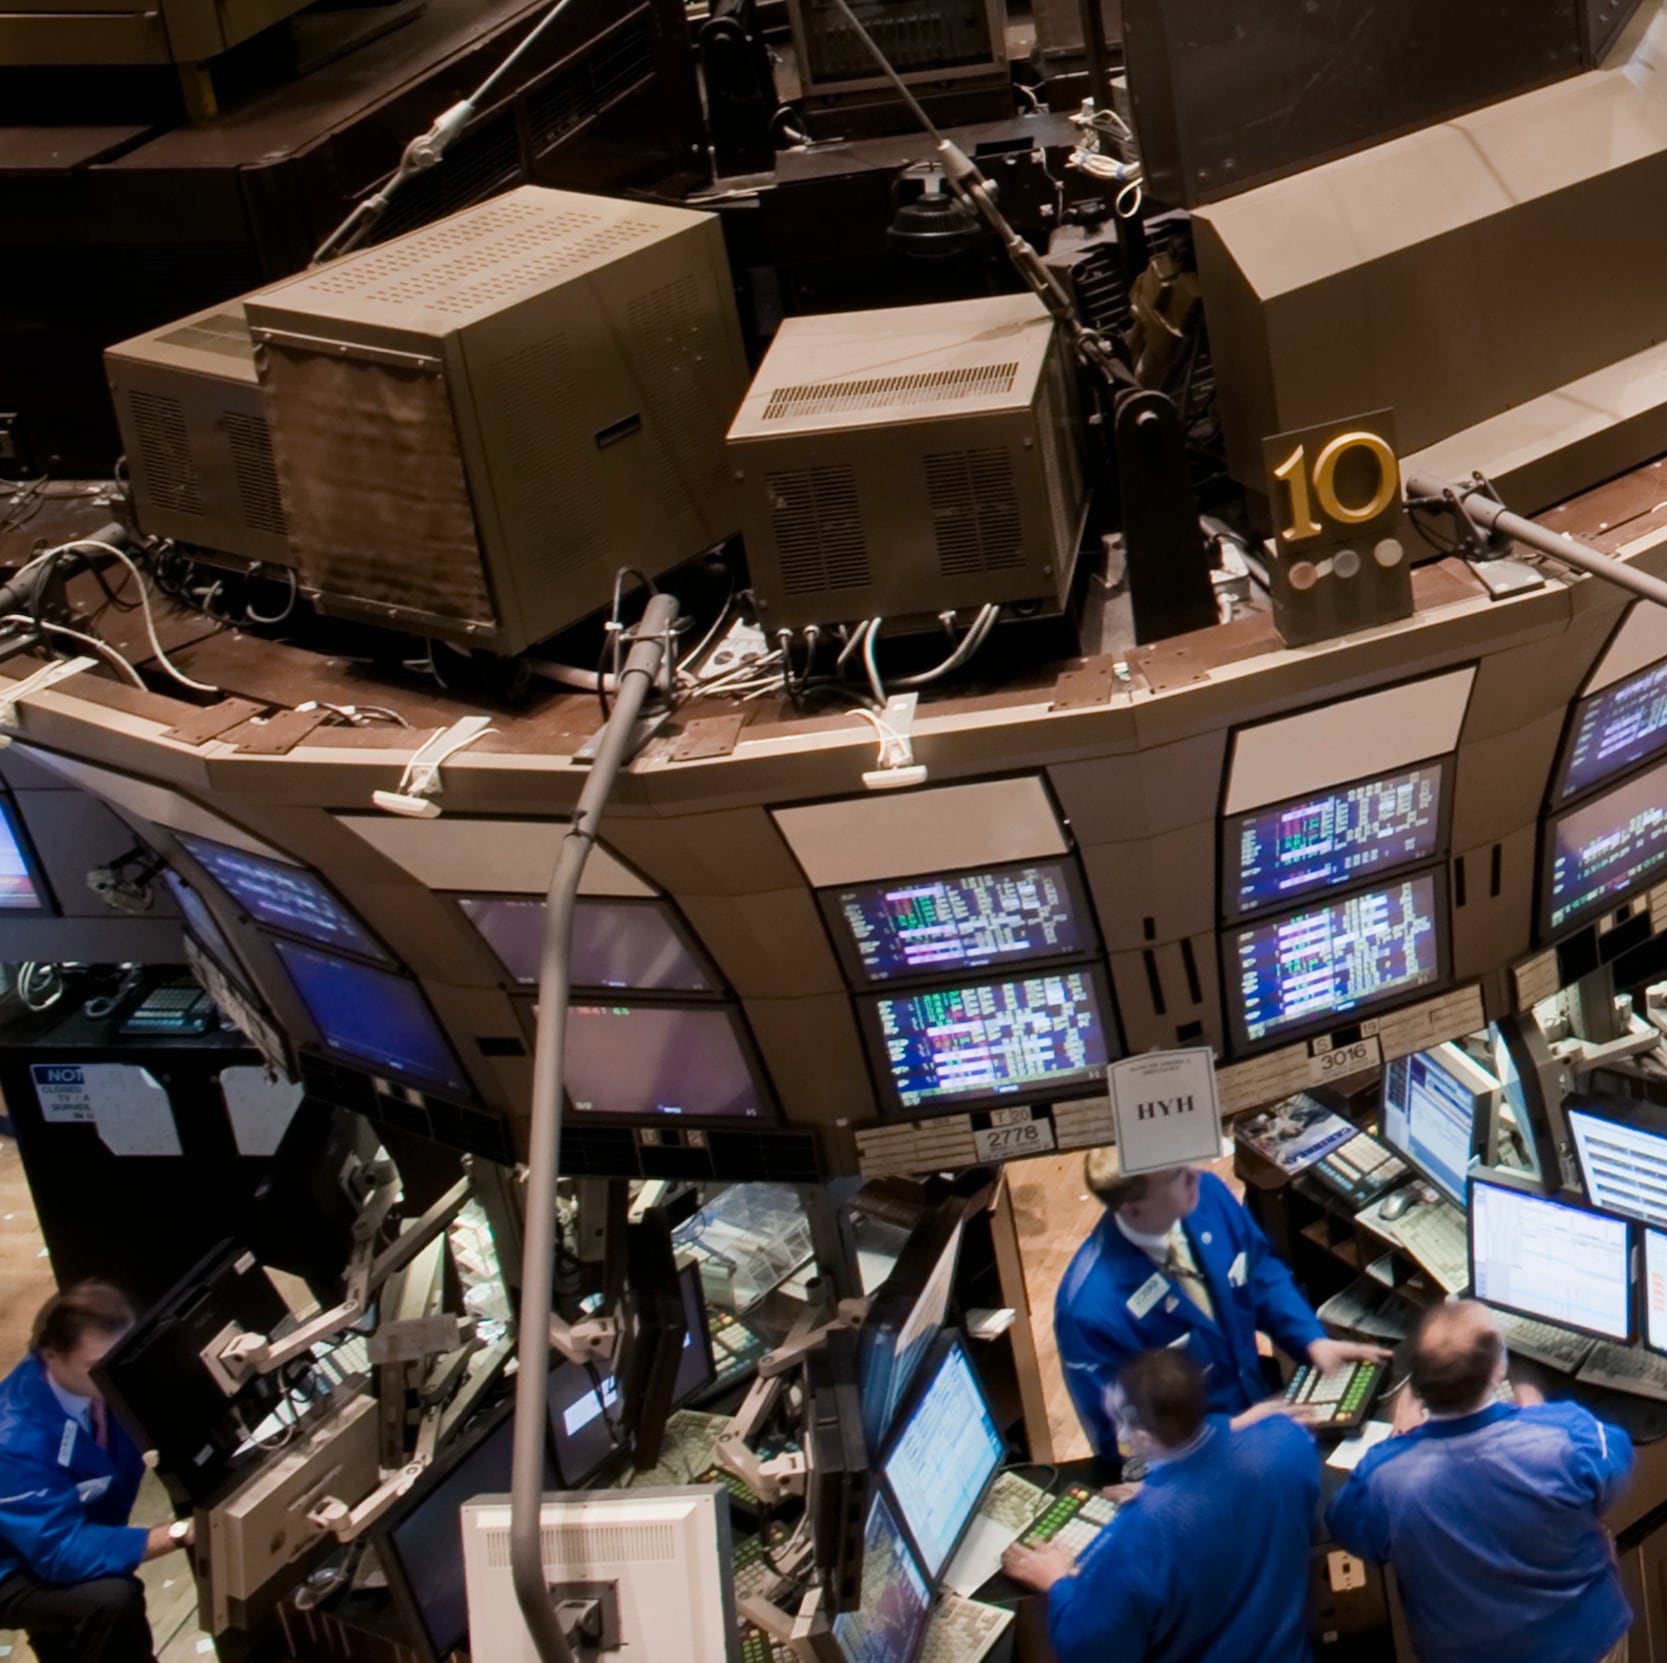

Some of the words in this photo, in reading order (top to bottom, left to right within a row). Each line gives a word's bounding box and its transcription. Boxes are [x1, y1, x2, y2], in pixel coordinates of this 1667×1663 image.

[1274, 431, 1398, 541] 10
[1316, 1039, 1328, 1051] S
[1321, 1043, 1367, 1070] 3016
[994, 1112, 1004, 1123] T
[1011, 1109, 1030, 1122] 20
[1136, 1095, 1195, 1122] HYH
[987, 1124, 1039, 1148] 2778
